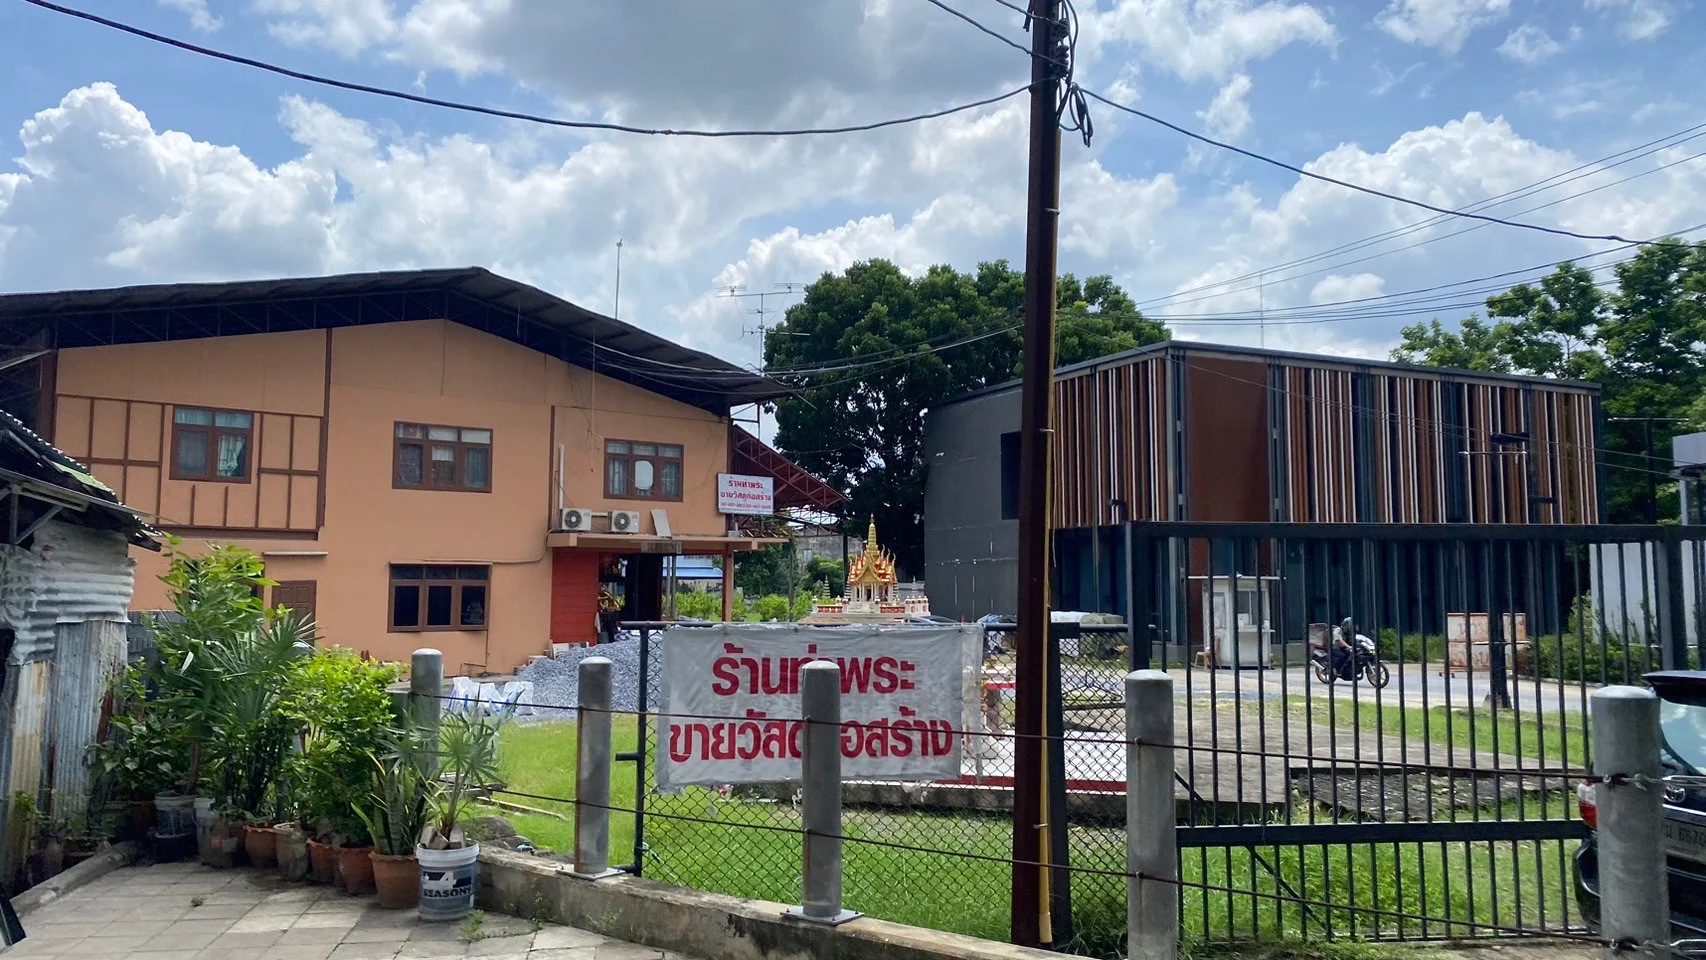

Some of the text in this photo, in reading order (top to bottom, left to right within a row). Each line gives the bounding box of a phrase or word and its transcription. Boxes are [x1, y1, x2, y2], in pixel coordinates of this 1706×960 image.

[711, 643, 915, 696] ร้านท่พระ
[423, 885, 471, 898] SEASONS
